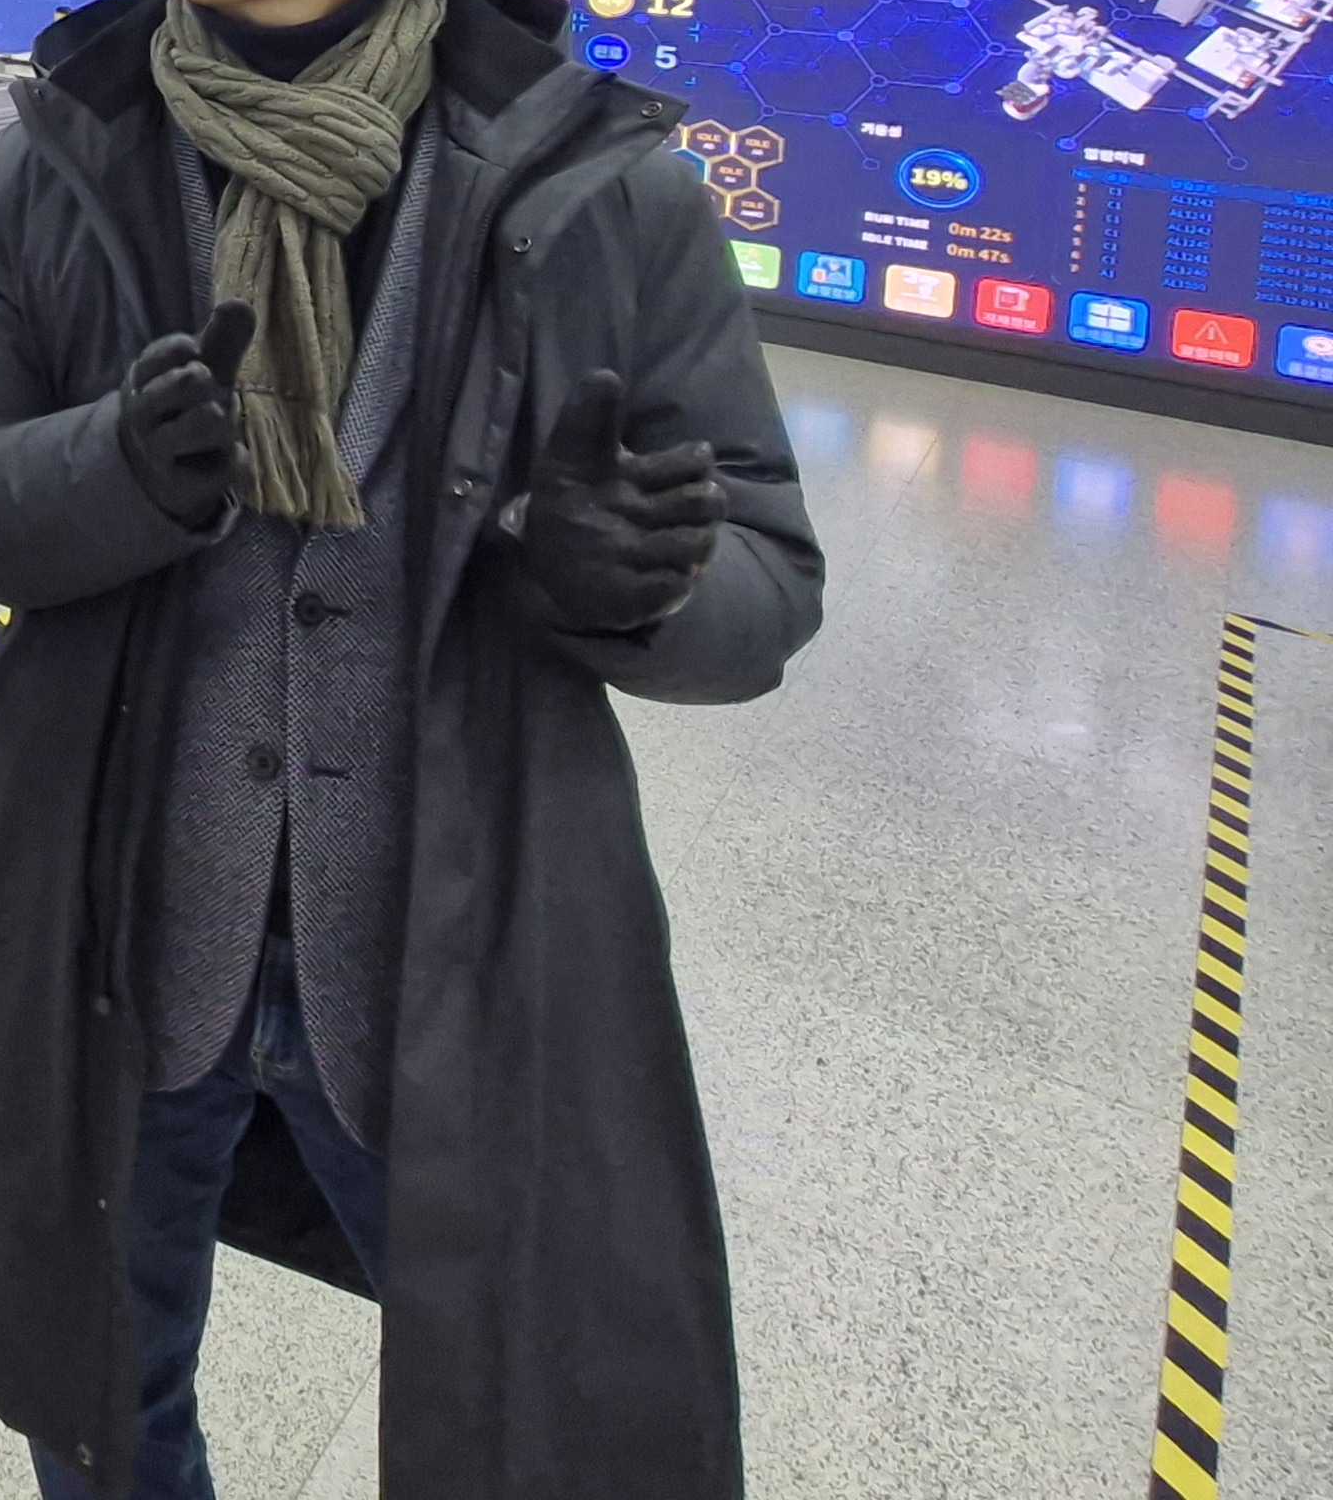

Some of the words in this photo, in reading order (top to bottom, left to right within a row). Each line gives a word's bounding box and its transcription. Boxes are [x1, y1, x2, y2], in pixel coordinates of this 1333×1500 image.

[654, 45, 677, 69] 5
[910, 167, 969, 190] 19%
[897, 215, 931, 230] TIME
[948, 222, 977, 239] 0m
[979, 226, 1014, 243] 22s
[894, 236, 929, 251] TIME
[946, 243, 976, 259] 0m
[978, 248, 1013, 264] 47s
